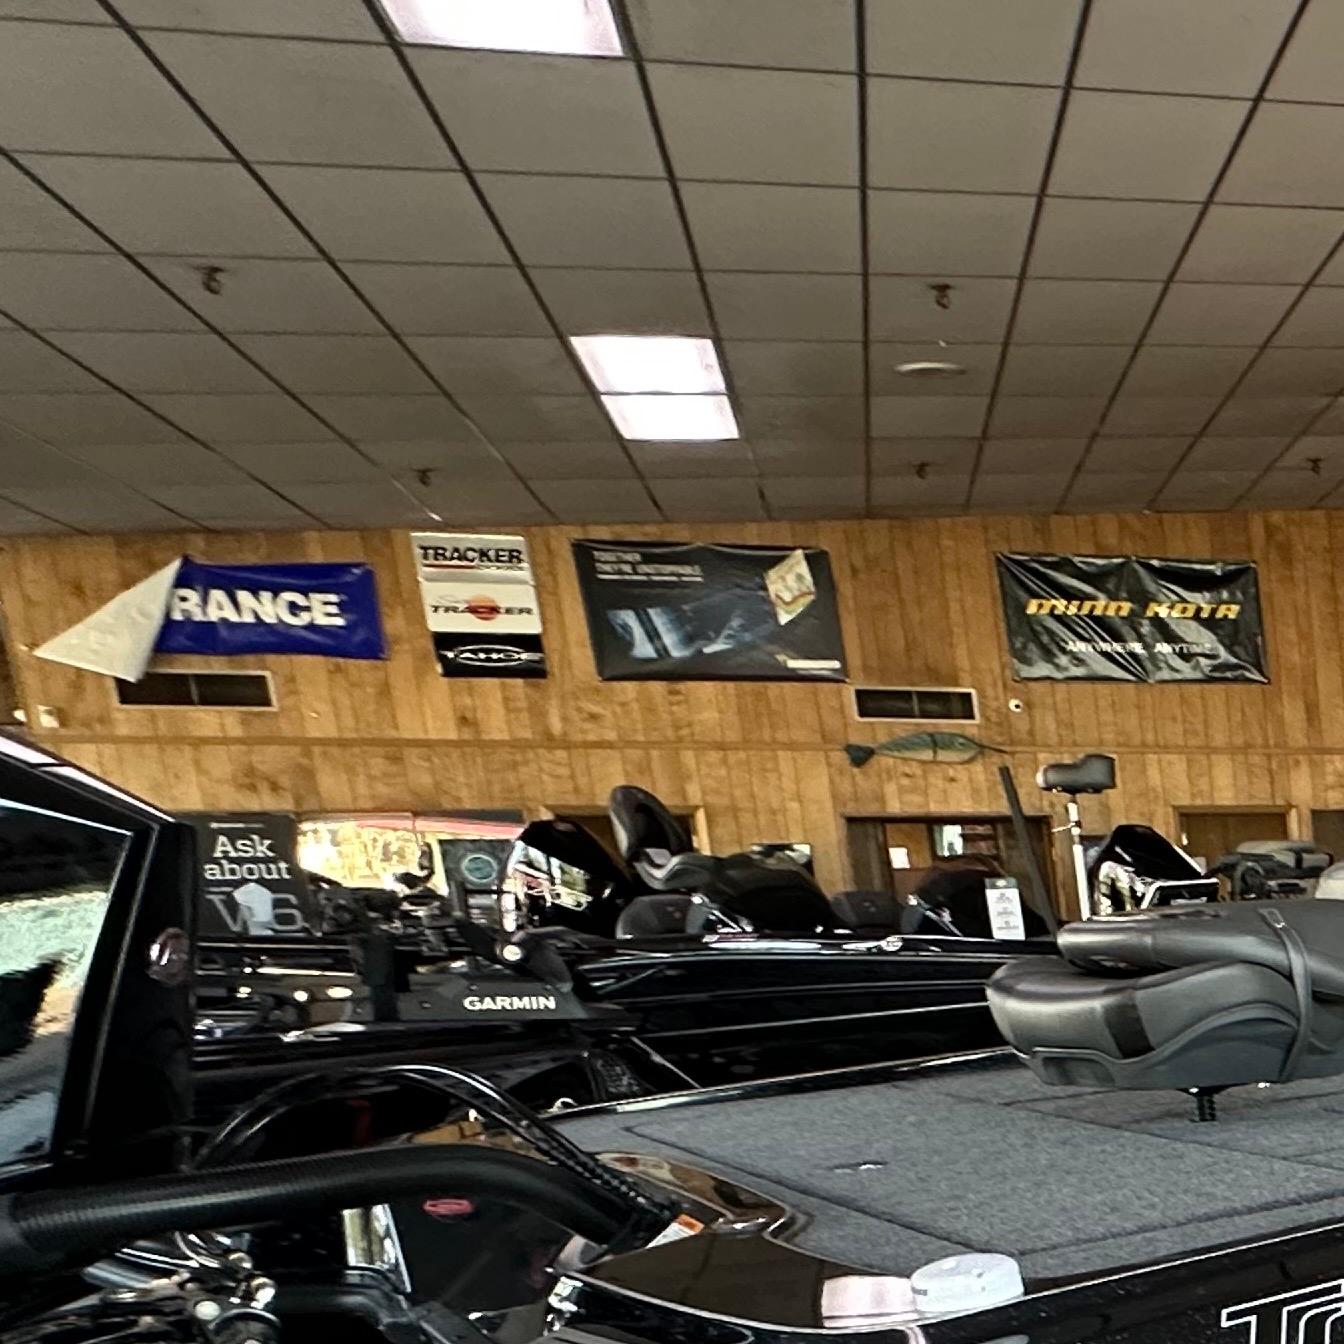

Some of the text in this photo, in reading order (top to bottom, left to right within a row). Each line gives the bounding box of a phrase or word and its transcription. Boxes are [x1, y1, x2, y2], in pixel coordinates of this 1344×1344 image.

[419, 545, 525, 563] TRACKER
[169, 587, 347, 627] RANCE
[1145, 602, 1242, 619] KOTA
[212, 834, 276, 858] Ask
[203, 859, 292, 881] about
[462, 995, 556, 1011] GARMIN
